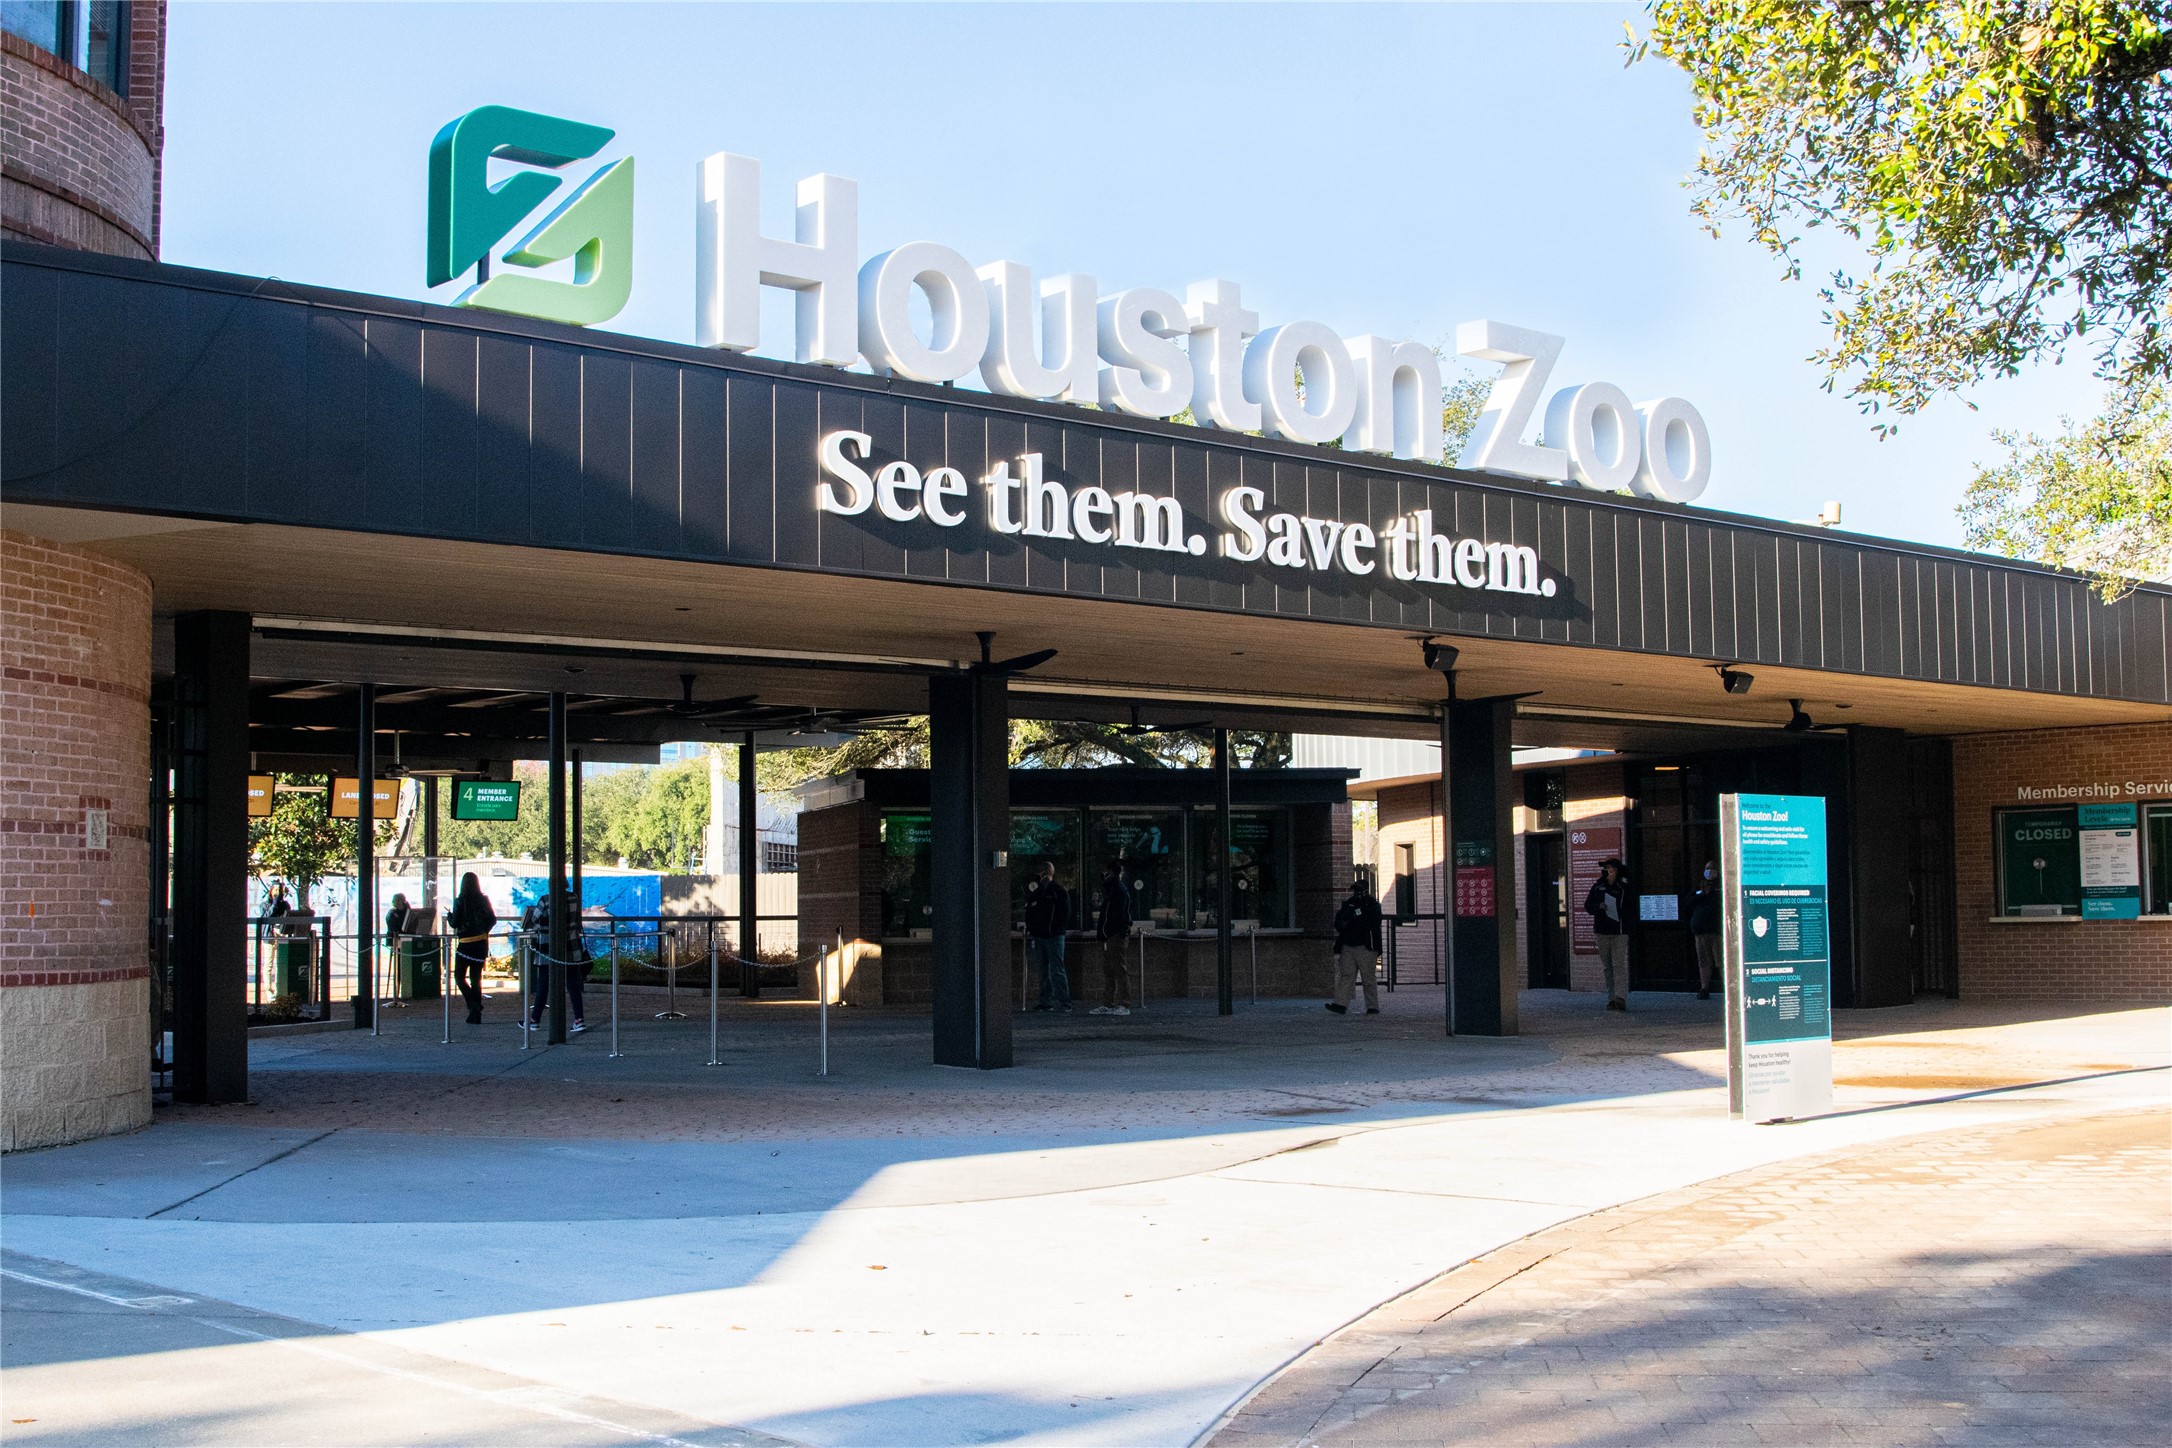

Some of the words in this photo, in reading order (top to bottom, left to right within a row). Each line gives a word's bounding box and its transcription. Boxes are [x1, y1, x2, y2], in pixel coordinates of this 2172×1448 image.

[696, 150, 1443, 461] Houston
[1456, 319, 1712, 503] Zoo
[818, 430, 969, 527] See
[983, 452, 1207, 556] them.
[1221, 485, 1377, 576] Save
[1384, 508, 1557, 598] them.
[463, 787, 473, 801] 4
[2017, 782, 2120, 800] Membership
[1742, 809, 1772, 821] Houston
[1772, 810, 1789, 822] Zoo!
[2084, 806, 2131, 815] Membership
[2015, 828, 2073, 841] CLOSED
[1751, 967, 1767, 975] SOCIAL
